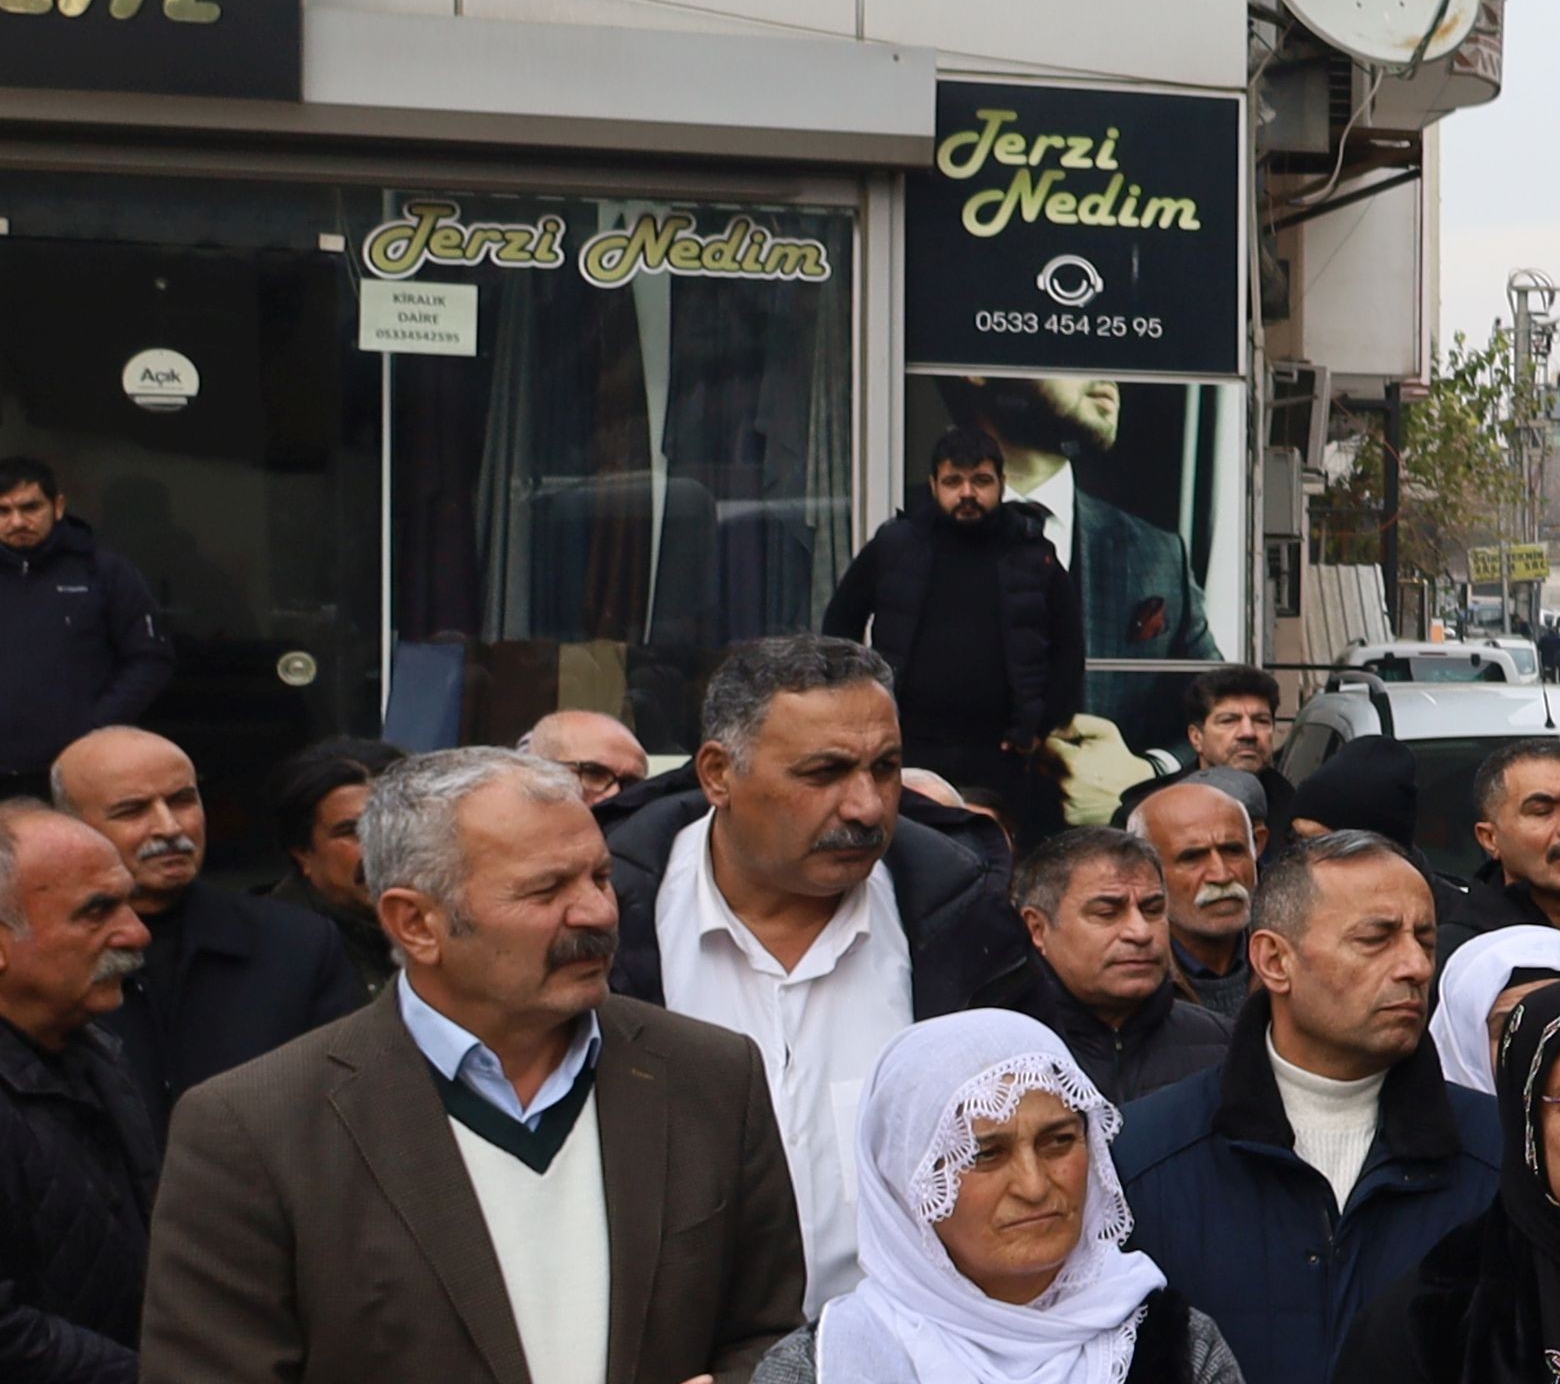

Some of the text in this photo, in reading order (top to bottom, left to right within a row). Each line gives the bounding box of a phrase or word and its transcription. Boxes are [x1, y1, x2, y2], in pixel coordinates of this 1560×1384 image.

[961, 169, 1201, 238] Nedim
[583, 215, 828, 286] Nedim
[393, 292, 447, 307] KİRALIK
[975, 310, 1164, 340] 0533 454 25 95
[140, 367, 182, 388] Açık
